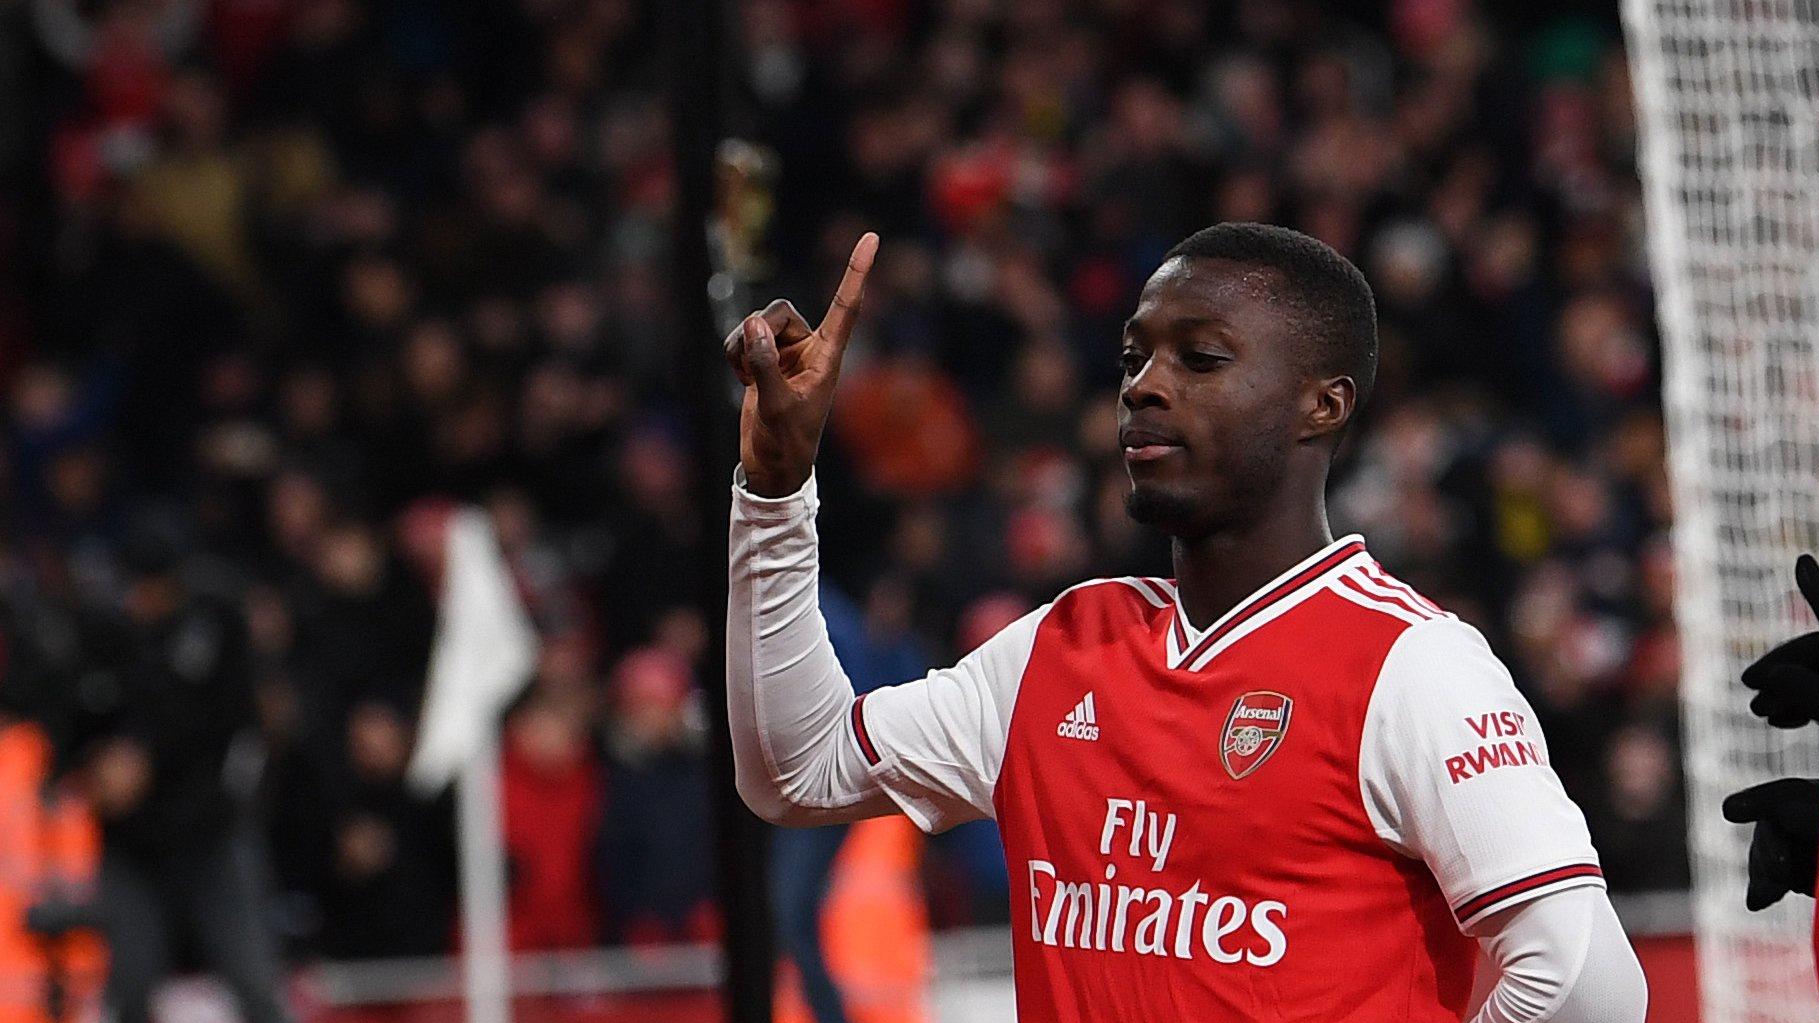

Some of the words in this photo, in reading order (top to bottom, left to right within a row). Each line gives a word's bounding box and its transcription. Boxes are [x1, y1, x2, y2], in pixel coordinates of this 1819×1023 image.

[1057, 720, 1100, 741] adidas
[1234, 705, 1283, 721] Arsenal
[1445, 740, 1548, 785] RWAN
[1100, 798, 1177, 872] Fly
[1028, 863, 1288, 967] Emirates
